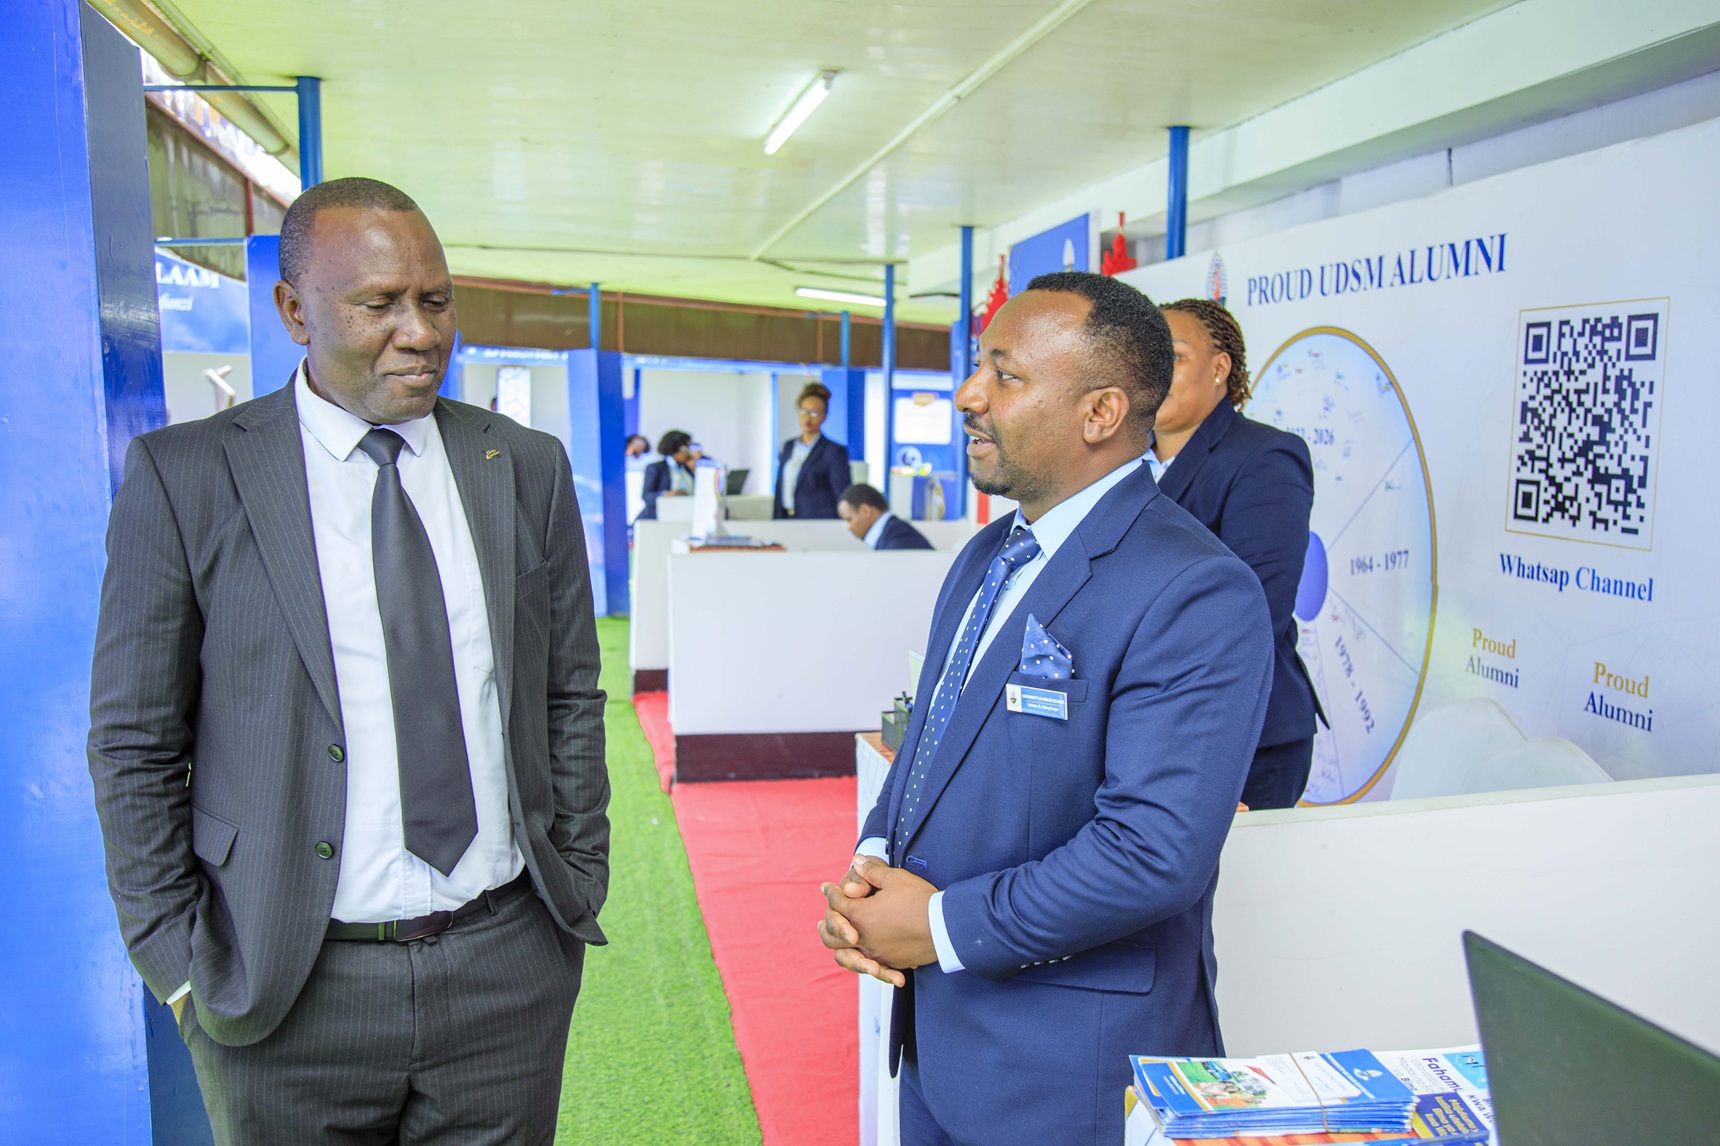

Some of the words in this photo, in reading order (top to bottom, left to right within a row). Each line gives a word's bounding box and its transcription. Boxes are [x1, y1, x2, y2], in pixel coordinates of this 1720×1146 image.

[1247, 268, 1312, 306] PROUD
[1319, 254, 1385, 297] UDSM
[1389, 233, 1508, 287] ALUMNI
[1350, 556, 1373, 576] 1964
[1384, 550, 1409, 571] 1977
[1500, 553, 1569, 592] Whatsap
[1575, 566, 1653, 602] Channel
[1472, 628, 1516, 659] Proud
[1334, 636, 1354, 678] 1978
[1354, 691, 1375, 734] 1992
[1465, 655, 1519, 689] Alumni
[1593, 661, 1649, 698] Proud
[1584, 691, 1653, 732] Alumni
